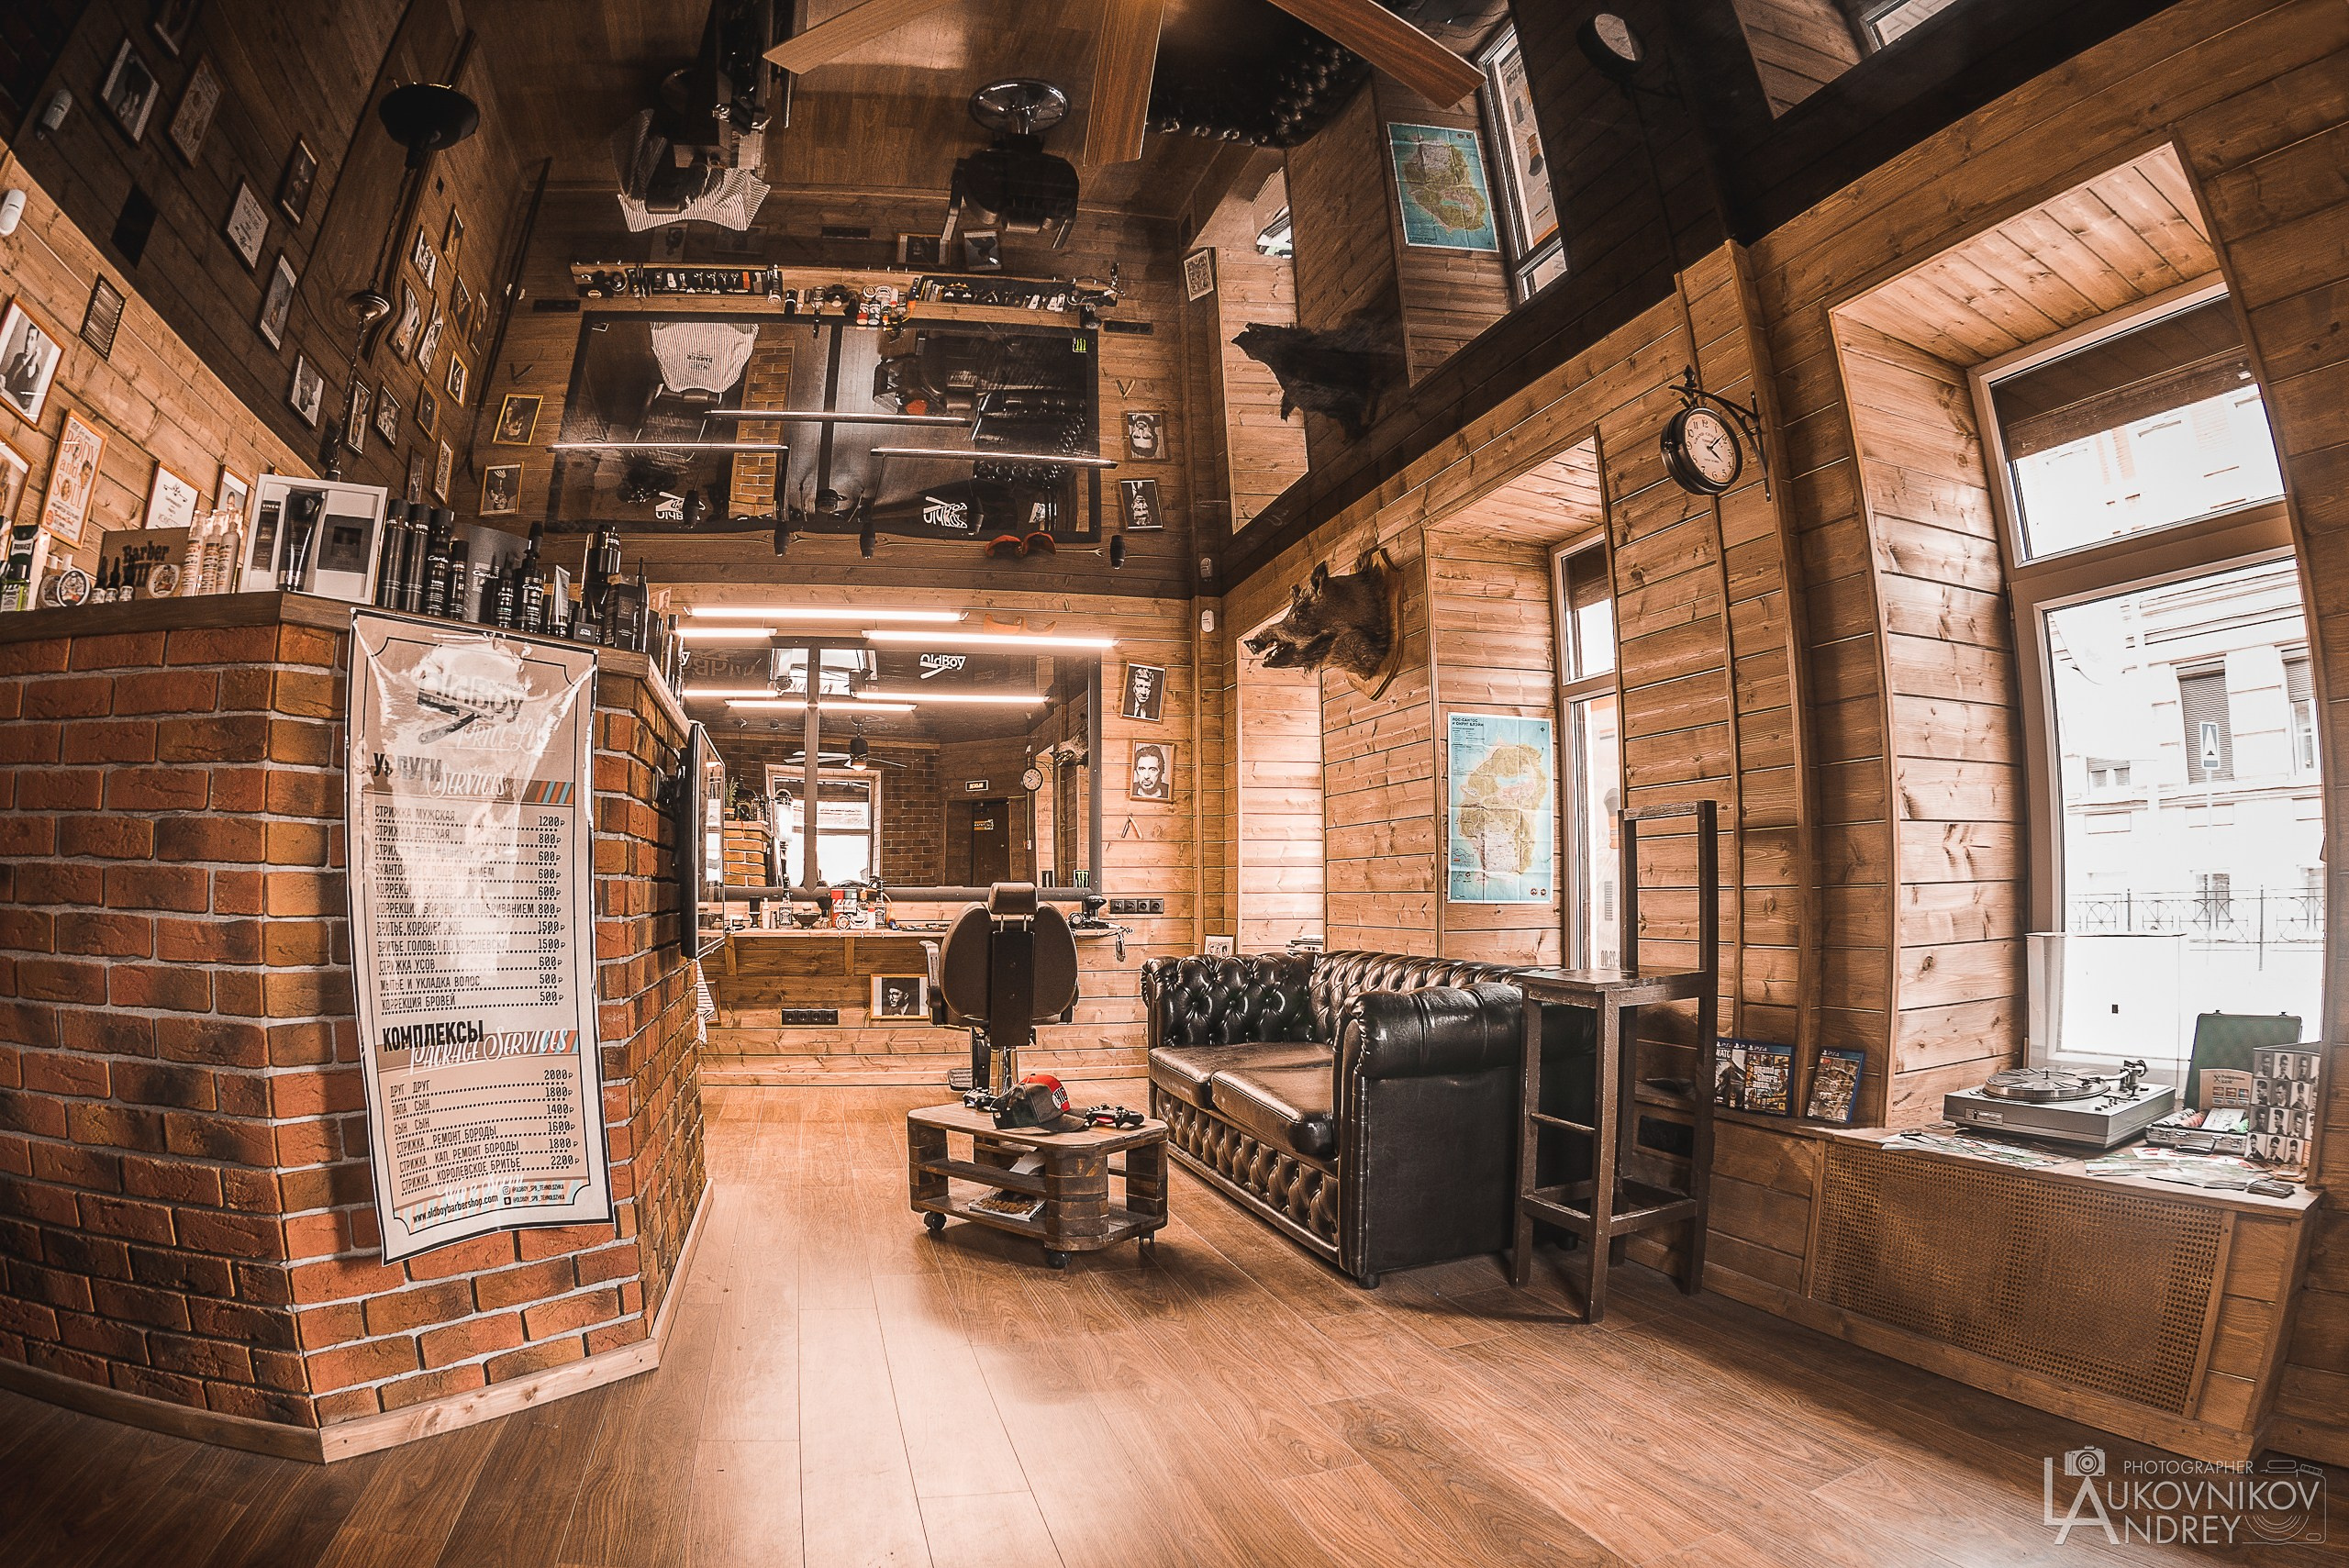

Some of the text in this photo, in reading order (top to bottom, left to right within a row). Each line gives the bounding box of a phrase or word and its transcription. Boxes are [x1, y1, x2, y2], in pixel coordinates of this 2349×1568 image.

[60, 459, 79, 478] and
[52, 473, 84, 509] SOUL
[122, 539, 171, 563] Barber
[919, 654, 967, 671] OldBoy
[416, 808, 455, 821] МУЖСКАЯ
[415, 828, 450, 840] ДЕТСКАЯ
[407, 940, 440, 952] ГОЛОВЫ
[415, 959, 436, 970] УСОВ
[407, 978, 413, 990] И
[416, 977, 451, 990] УКЛАДКА
[454, 975, 480, 987] ВОЛОС
[382, 996, 422, 1010] КОРРЕКЦИЯ
[425, 993, 456, 1007] БРОВЕЙ
[382, 1019, 484, 1052] КОМПЛЕКСЫ
[483, 1025, 568, 1062] SERVICES
[390, 1084, 405, 1098] ДРУГ
[413, 1079, 430, 1094] ДРУГ
[392, 1102, 408, 1117] ПАПА
[414, 1098, 430, 1112] СЫН
[394, 1121, 408, 1136] СЫН
[415, 1118, 430, 1130] СЫН
[395, 1137, 426, 1154] СТРИЖКА
[432, 1130, 462, 1145] РЕМОНТ
[464, 1125, 496, 1140] БОРОДЫ
[399, 1155, 428, 1173] СТРИЖКА
[452, 1145, 482, 1160] РЕМОНТ
[484, 1140, 519, 1154] БОРОДЫ
[401, 1173, 430, 1192] СТРИЖКА
[436, 1162, 487, 1182] КОРОЛЕВСКОЕ
[490, 1157, 521, 1173] БРИТЬЕ
[413, 1194, 499, 1224] www.oldboybarbershop.com
